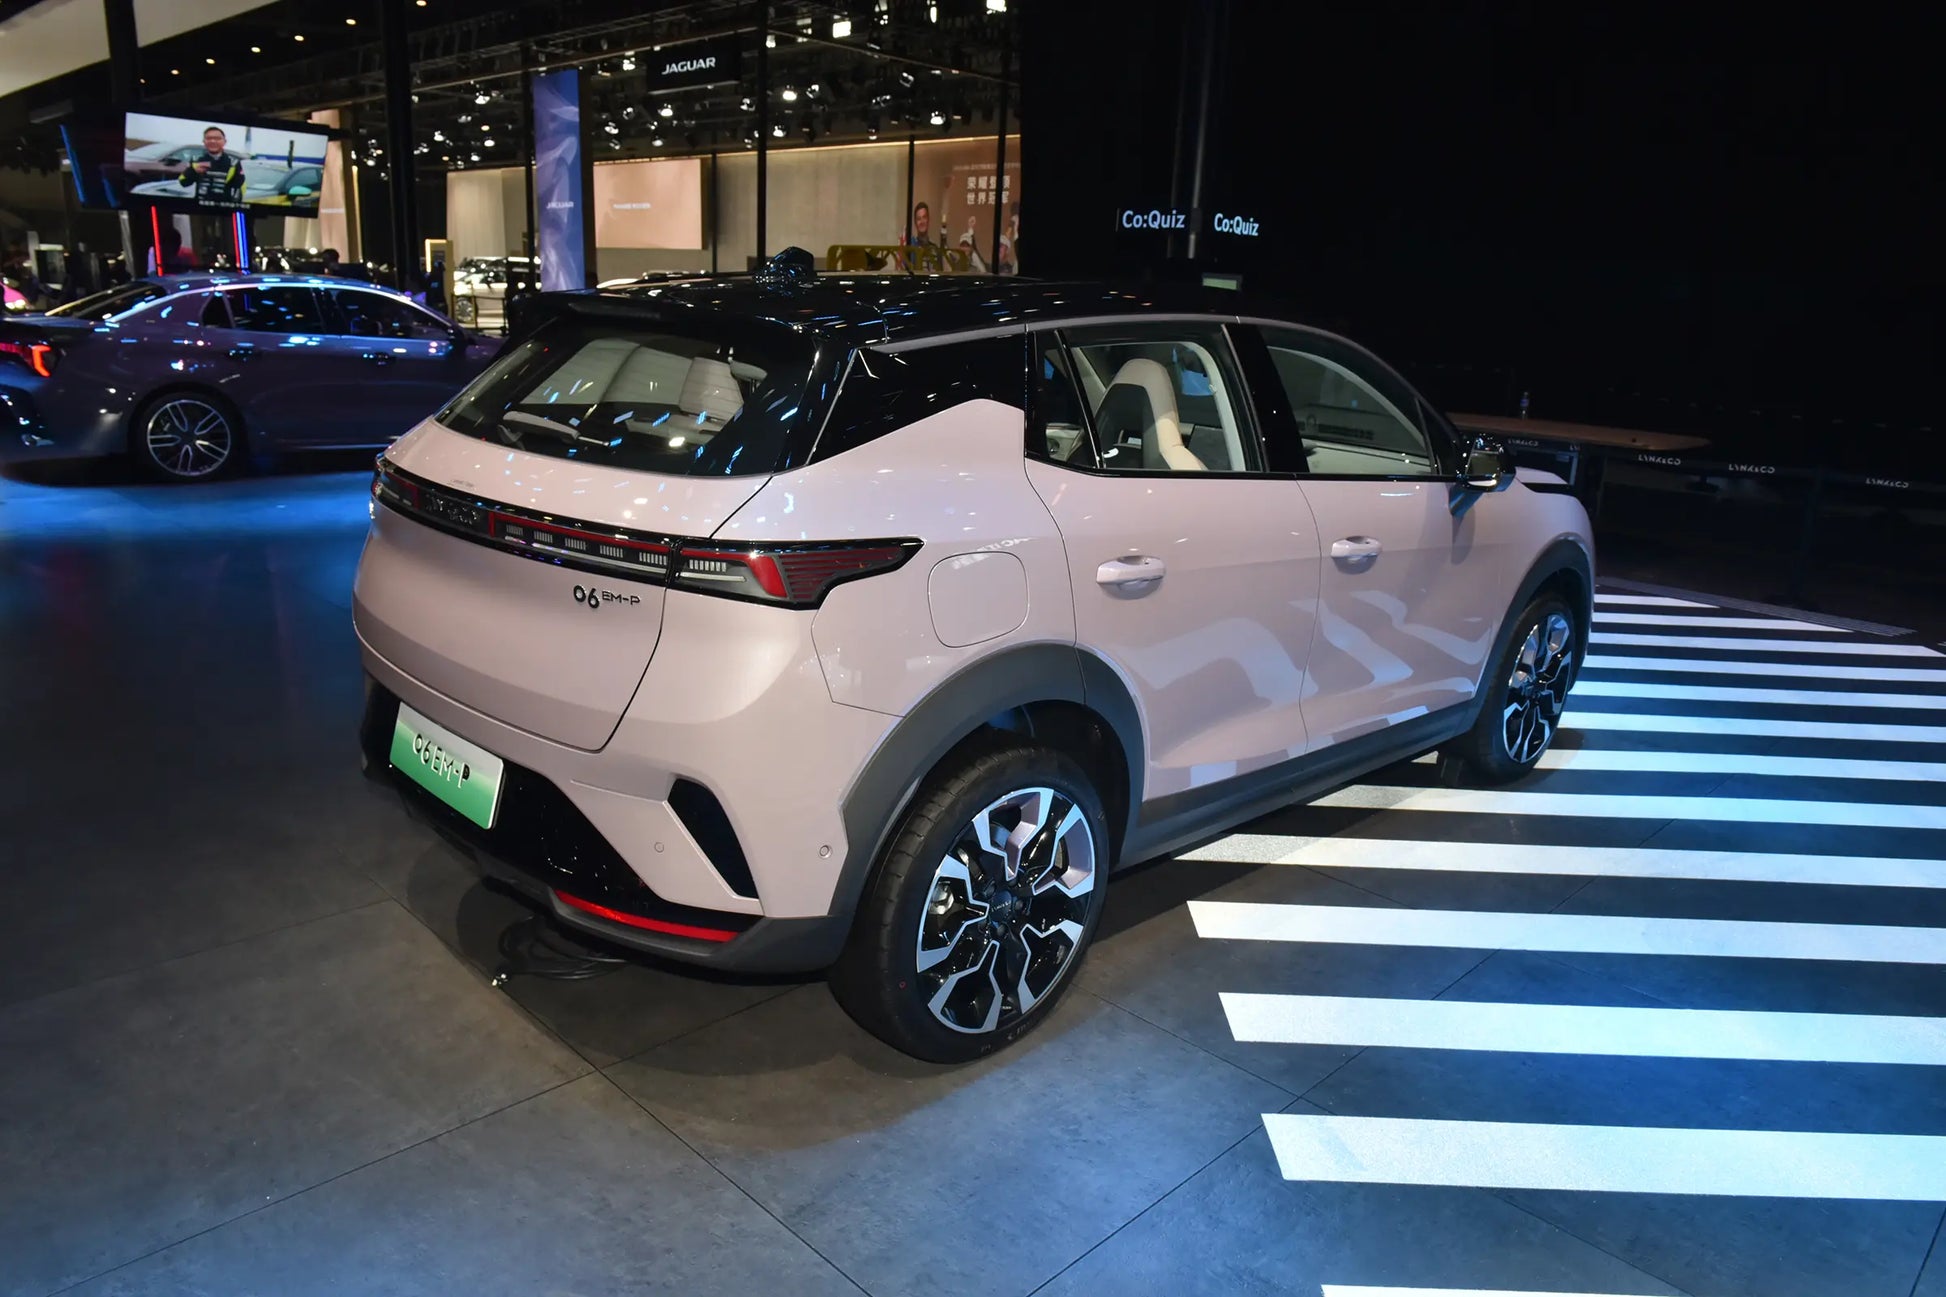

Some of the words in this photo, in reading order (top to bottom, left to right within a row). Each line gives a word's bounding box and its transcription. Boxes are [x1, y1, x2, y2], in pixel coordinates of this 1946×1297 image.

[661, 56, 716, 75] JAGUAR
[1122, 209, 1186, 229] Co:Quiz
[1214, 212, 1260, 236] Co:Quiz
[573, 584, 600, 609] 06
[601, 590, 641, 606] EM-P
